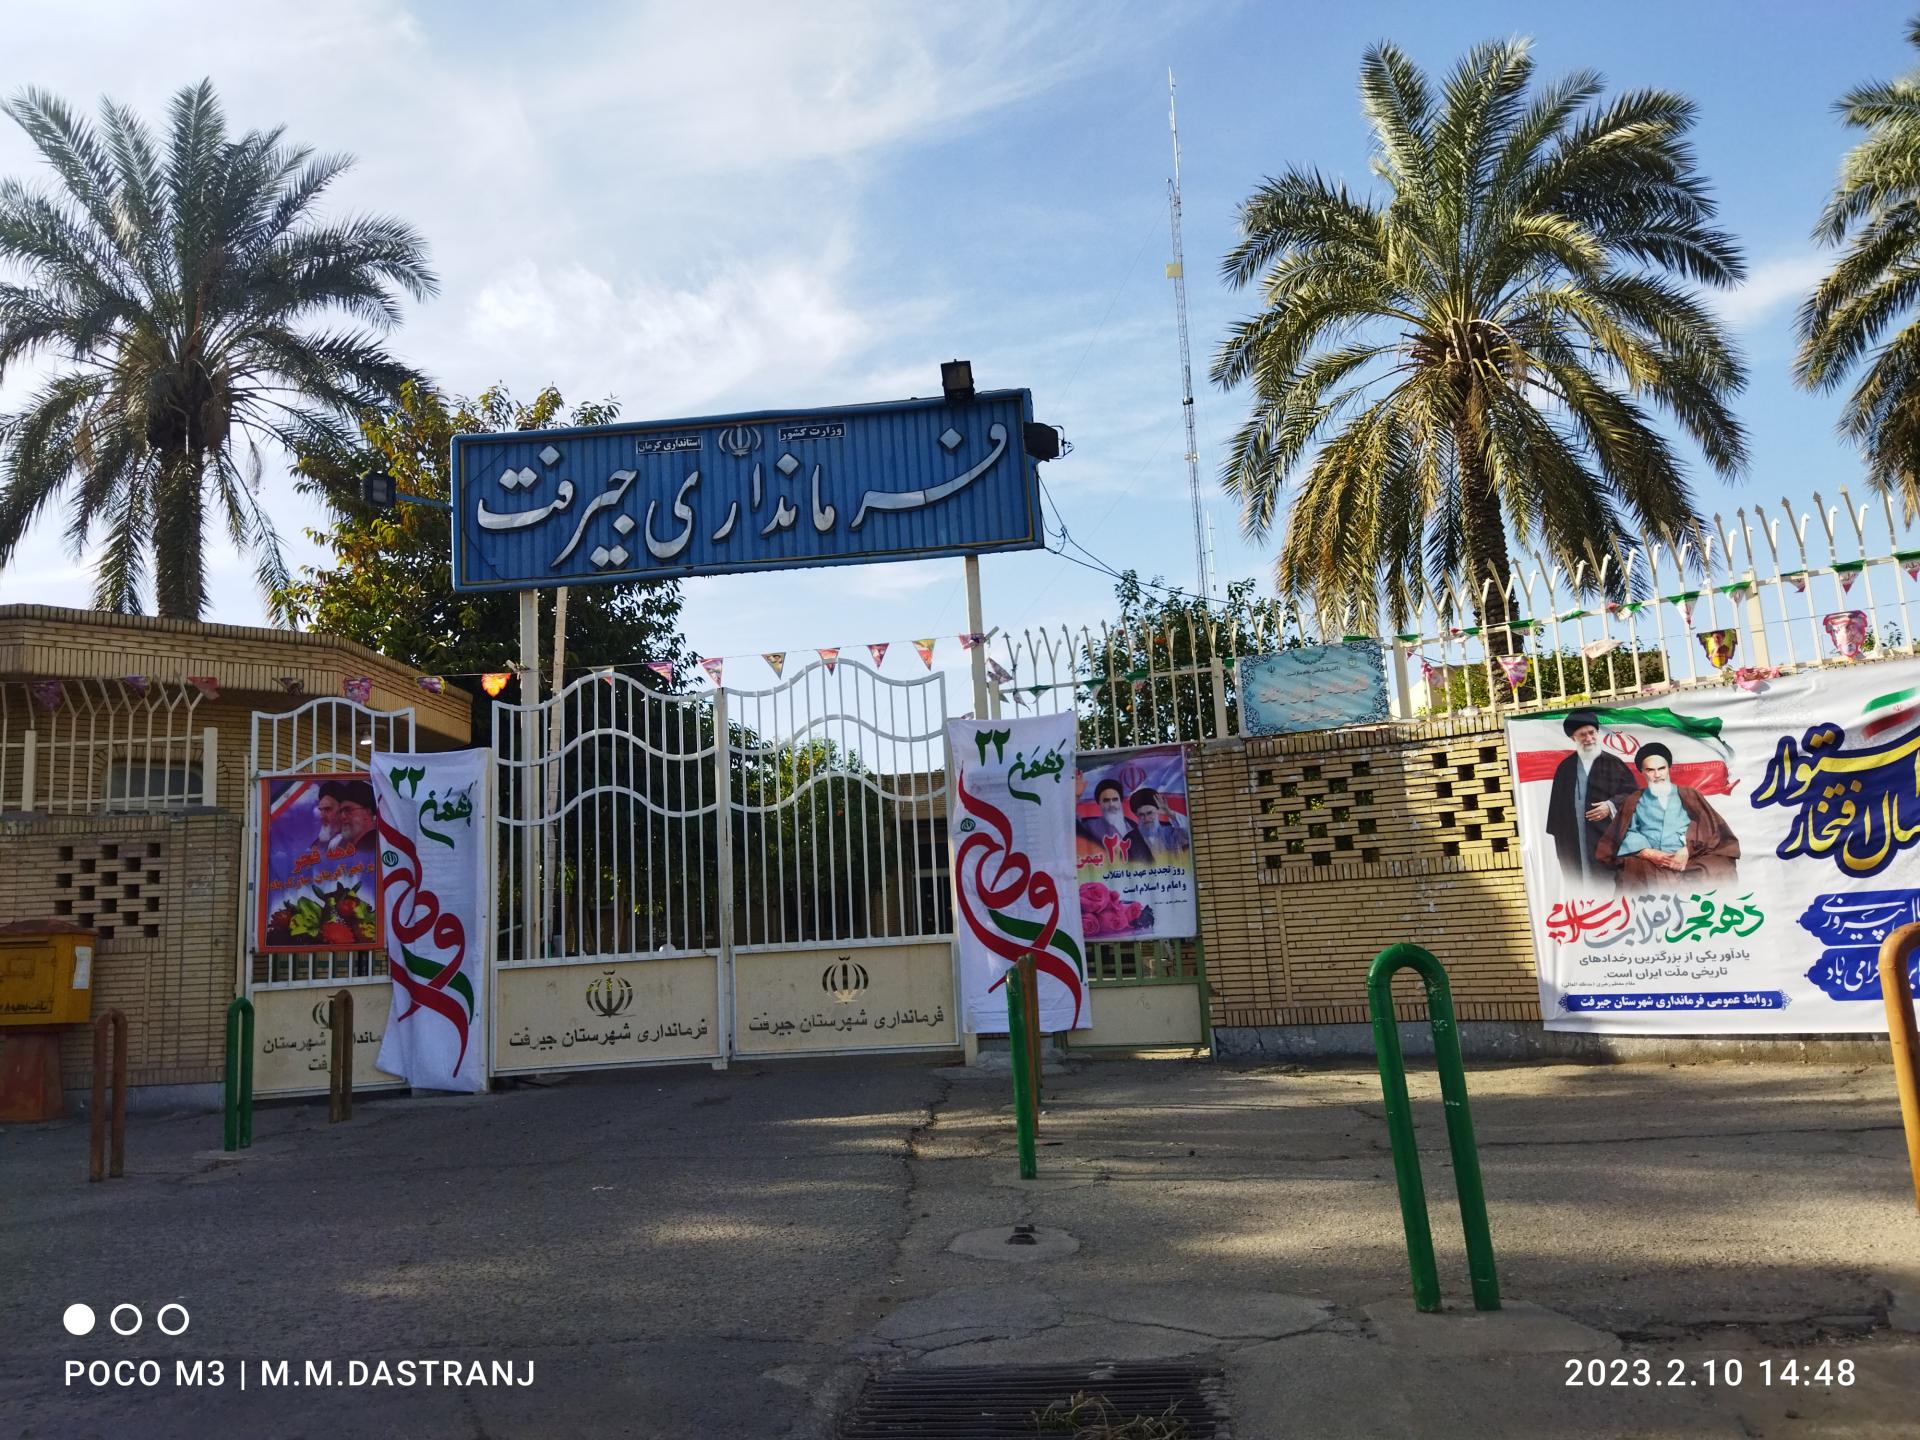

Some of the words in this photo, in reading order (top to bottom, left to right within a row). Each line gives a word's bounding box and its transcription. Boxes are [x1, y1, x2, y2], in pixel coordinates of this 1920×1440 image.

[780, 428, 807, 441] کشور
[809, 426, 842, 437] وزارت
[637, 441, 662, 453] کرمان
[663, 437, 701, 451] استانداری
[645, 422, 1008, 560] فرمانداری
[476, 444, 640, 569] جیرفت
[1007, 738, 1067, 807] بهمن
[418, 779, 478, 850] بهمن
[1784, 779, 1872, 853] افتخار
[1102, 870, 1125, 880] انقلاب
[1133, 868, 1147, 878] عهد
[1148, 865, 1172, 876] تجدید
[1171, 867, 1186, 876] روز
[1122, 885, 1139, 894] است
[1140, 882, 1160, 896] اسلام
[1166, 879, 1182, 893] امام
[1579, 953, 1633, 967] رخدادهای
[1634, 951, 1682, 965] بزرگترین
[1684, 951, 1693, 964] از
[1695, 951, 1717, 964] یکی
[1720, 949, 1750, 963] یادآور
[1635, 968, 1663, 981] ایران
[1691, 966, 1728, 980] تاریخی
[1580, 996, 1612, 1009] جیرفت
[1614, 995, 1654, 1009] شهرستان
[1655, 993, 1705, 1008] فرمانداری
[1706, 996, 1741, 1008] عمومی
[1742, 993, 1773, 1007] روابط
[748, 1012, 796, 1036] جیرفت
[799, 1009, 868, 1033] شهرستان
[874, 1006, 945, 1030] فرمانداری
[561, 1022, 631, 1048] شهرستان
[637, 1018, 709, 1043] فرمانداری
[262, 1031, 327, 1054] شهرستان
[508, 1027, 558, 1051] جیرفت
